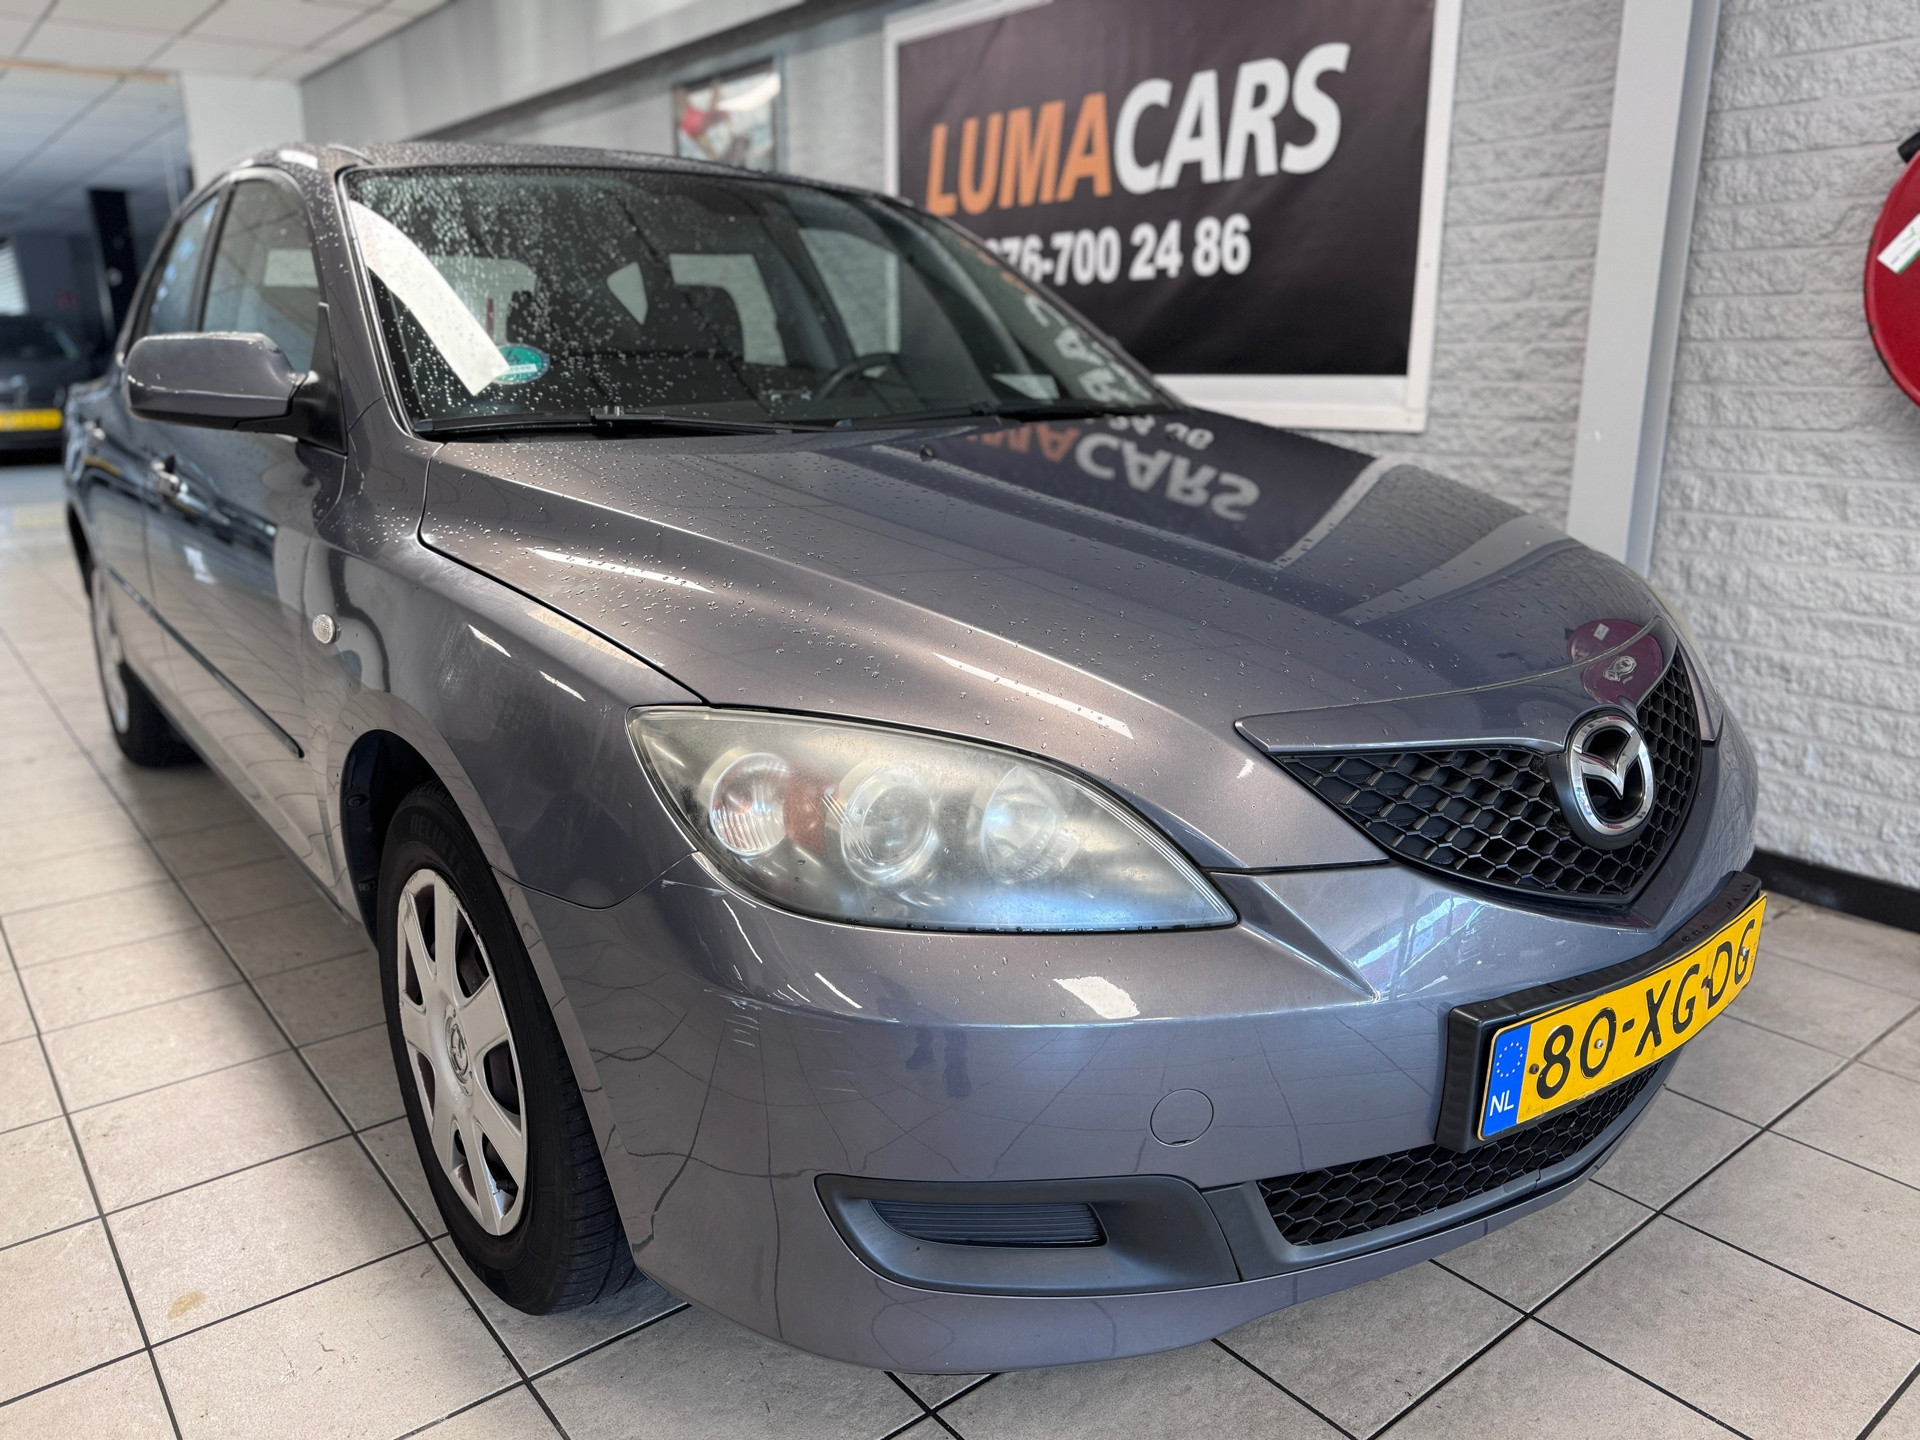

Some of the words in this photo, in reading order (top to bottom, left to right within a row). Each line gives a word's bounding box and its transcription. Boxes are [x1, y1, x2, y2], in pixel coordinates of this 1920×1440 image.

[926, 43, 1351, 216] LUMACARS
[1129, 219, 1183, 281] 24
[1192, 213, 1251, 277] 86
[1489, 1089, 1515, 1116] NL
